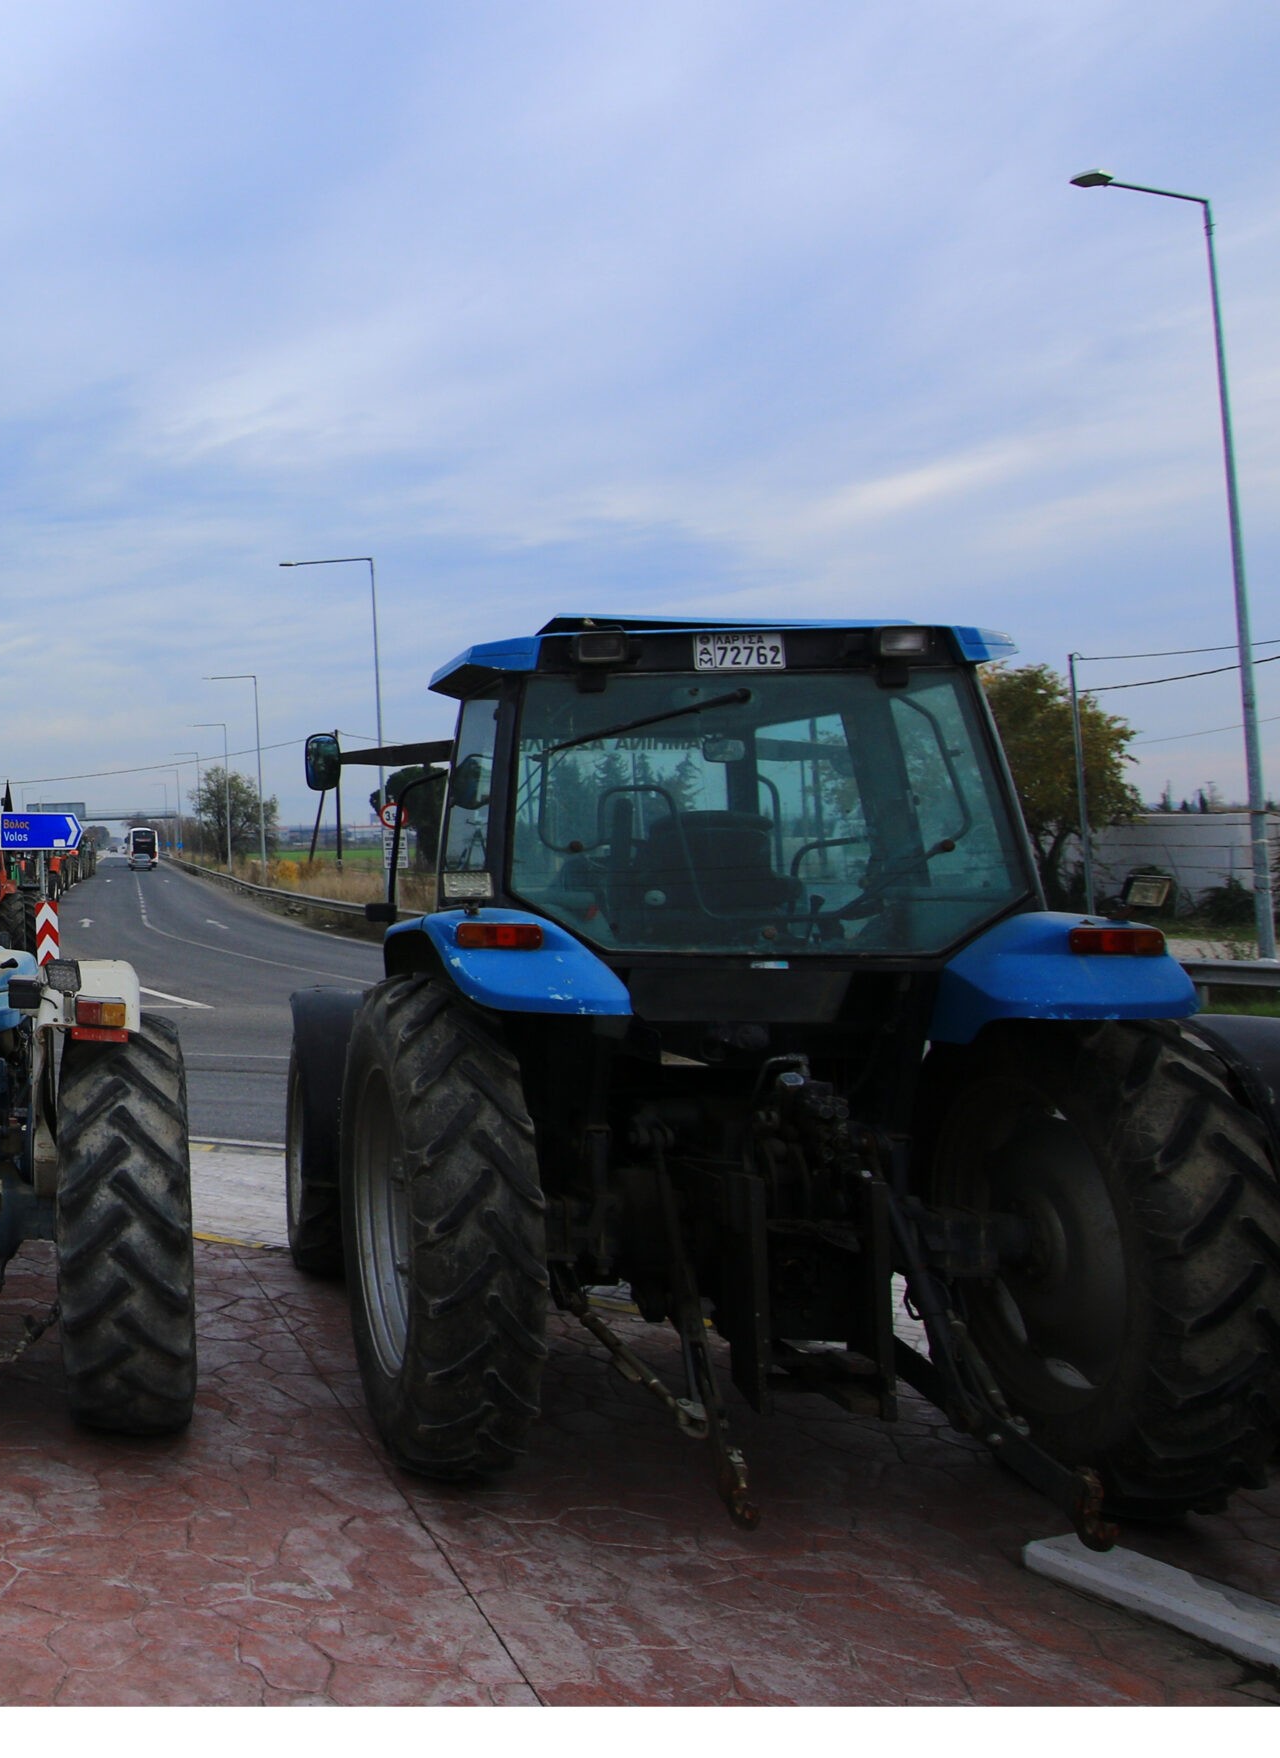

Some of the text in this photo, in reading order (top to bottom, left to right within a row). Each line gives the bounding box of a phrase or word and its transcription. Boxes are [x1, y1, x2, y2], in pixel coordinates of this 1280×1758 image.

[716, 645, 781, 666] 72762
[3, 818, 30, 831] Βόλος
[3, 831, 29, 842] Volos
